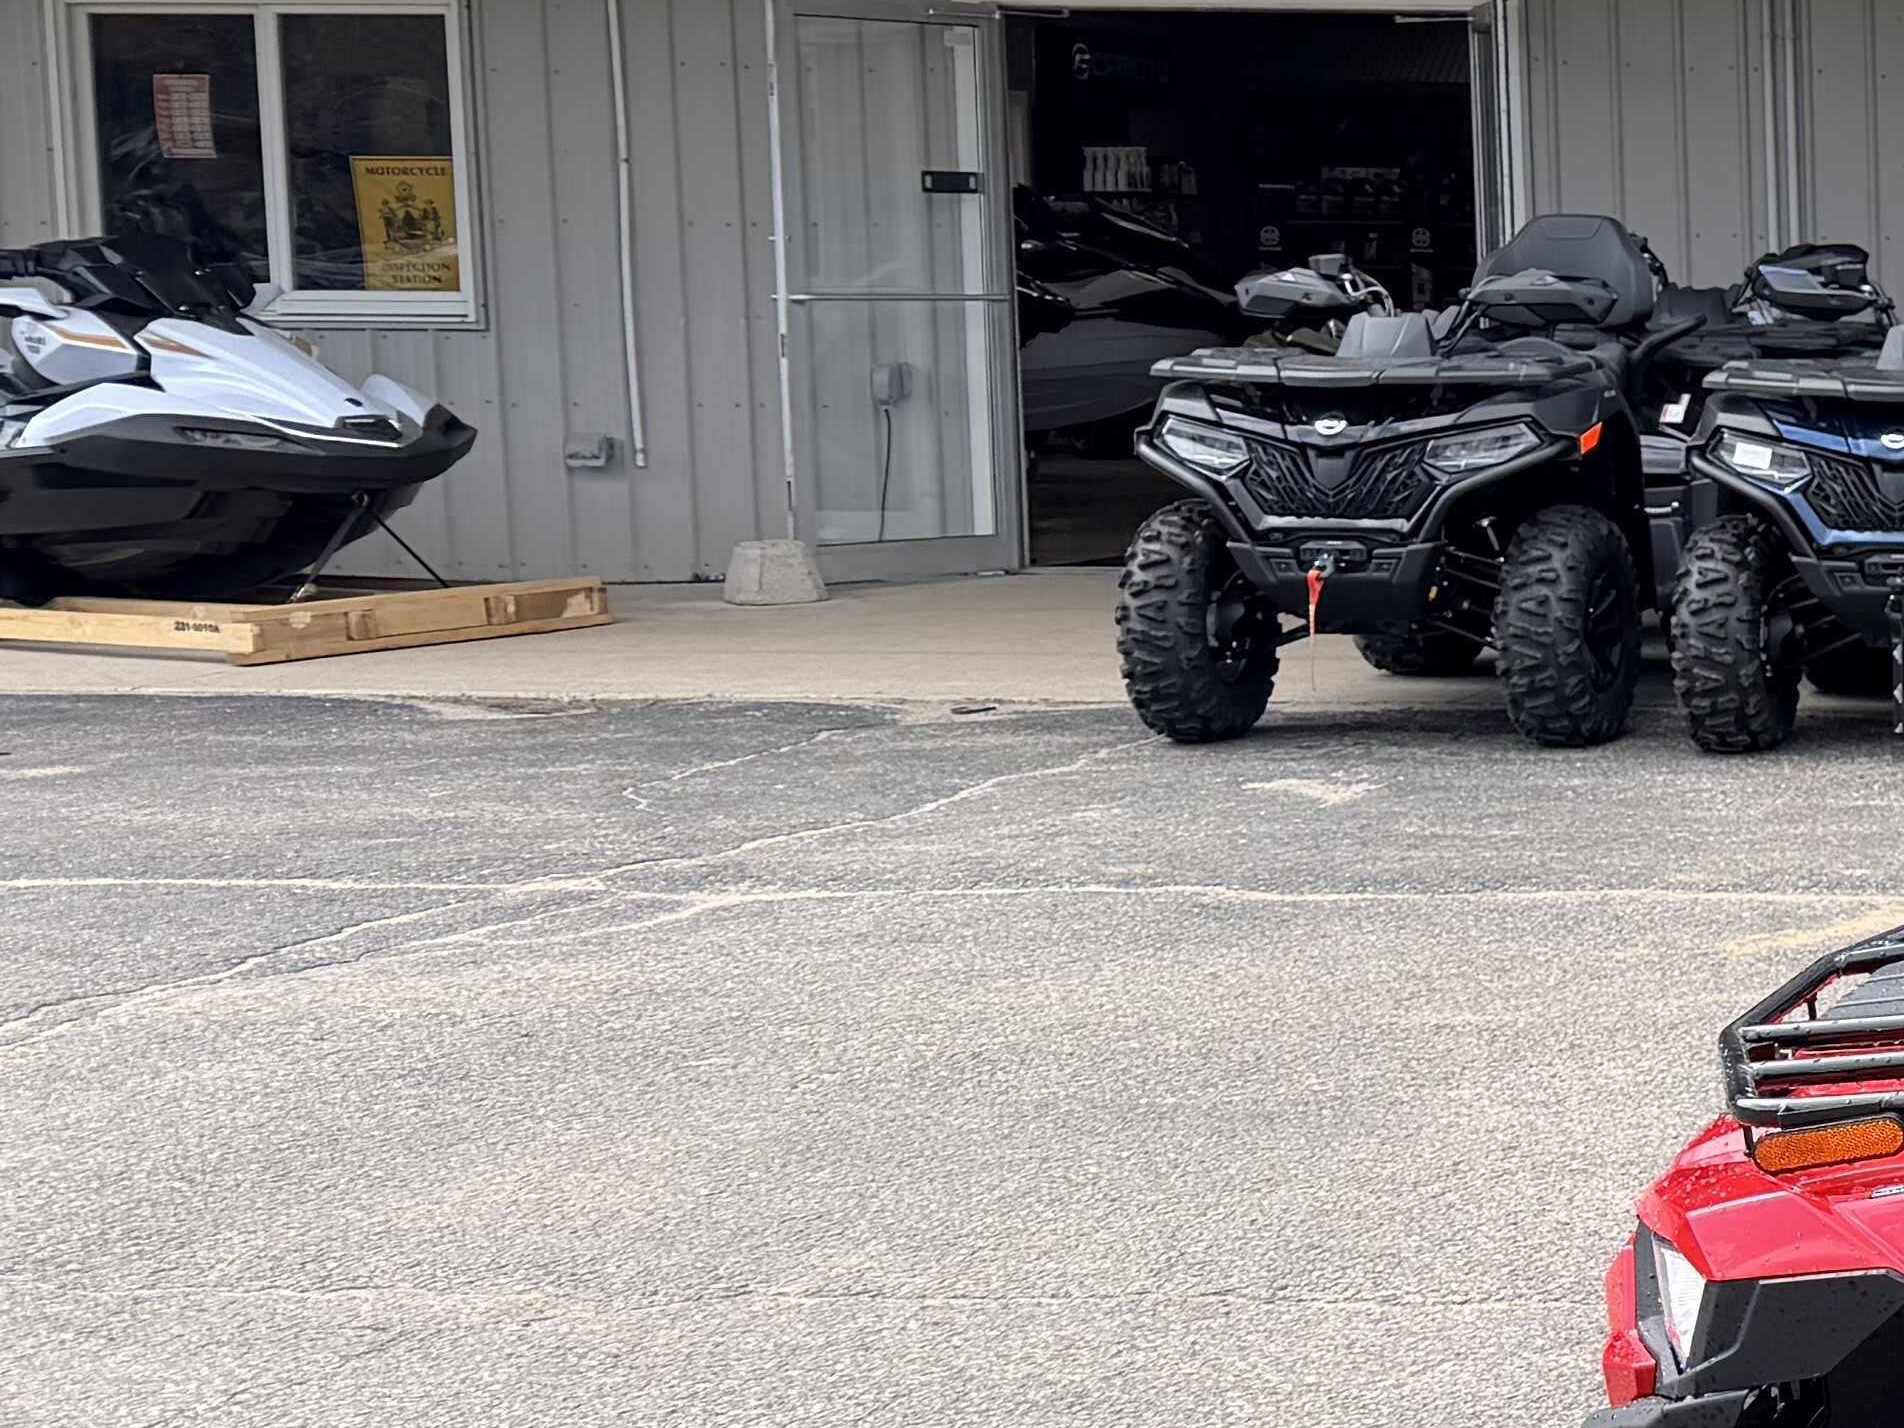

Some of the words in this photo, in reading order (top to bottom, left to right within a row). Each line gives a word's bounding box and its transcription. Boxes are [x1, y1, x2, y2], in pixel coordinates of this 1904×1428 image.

[365, 165, 448, 177] MOTORCYCLE
[381, 261, 451, 272] INSPECTION
[391, 274, 442, 285] STATION
